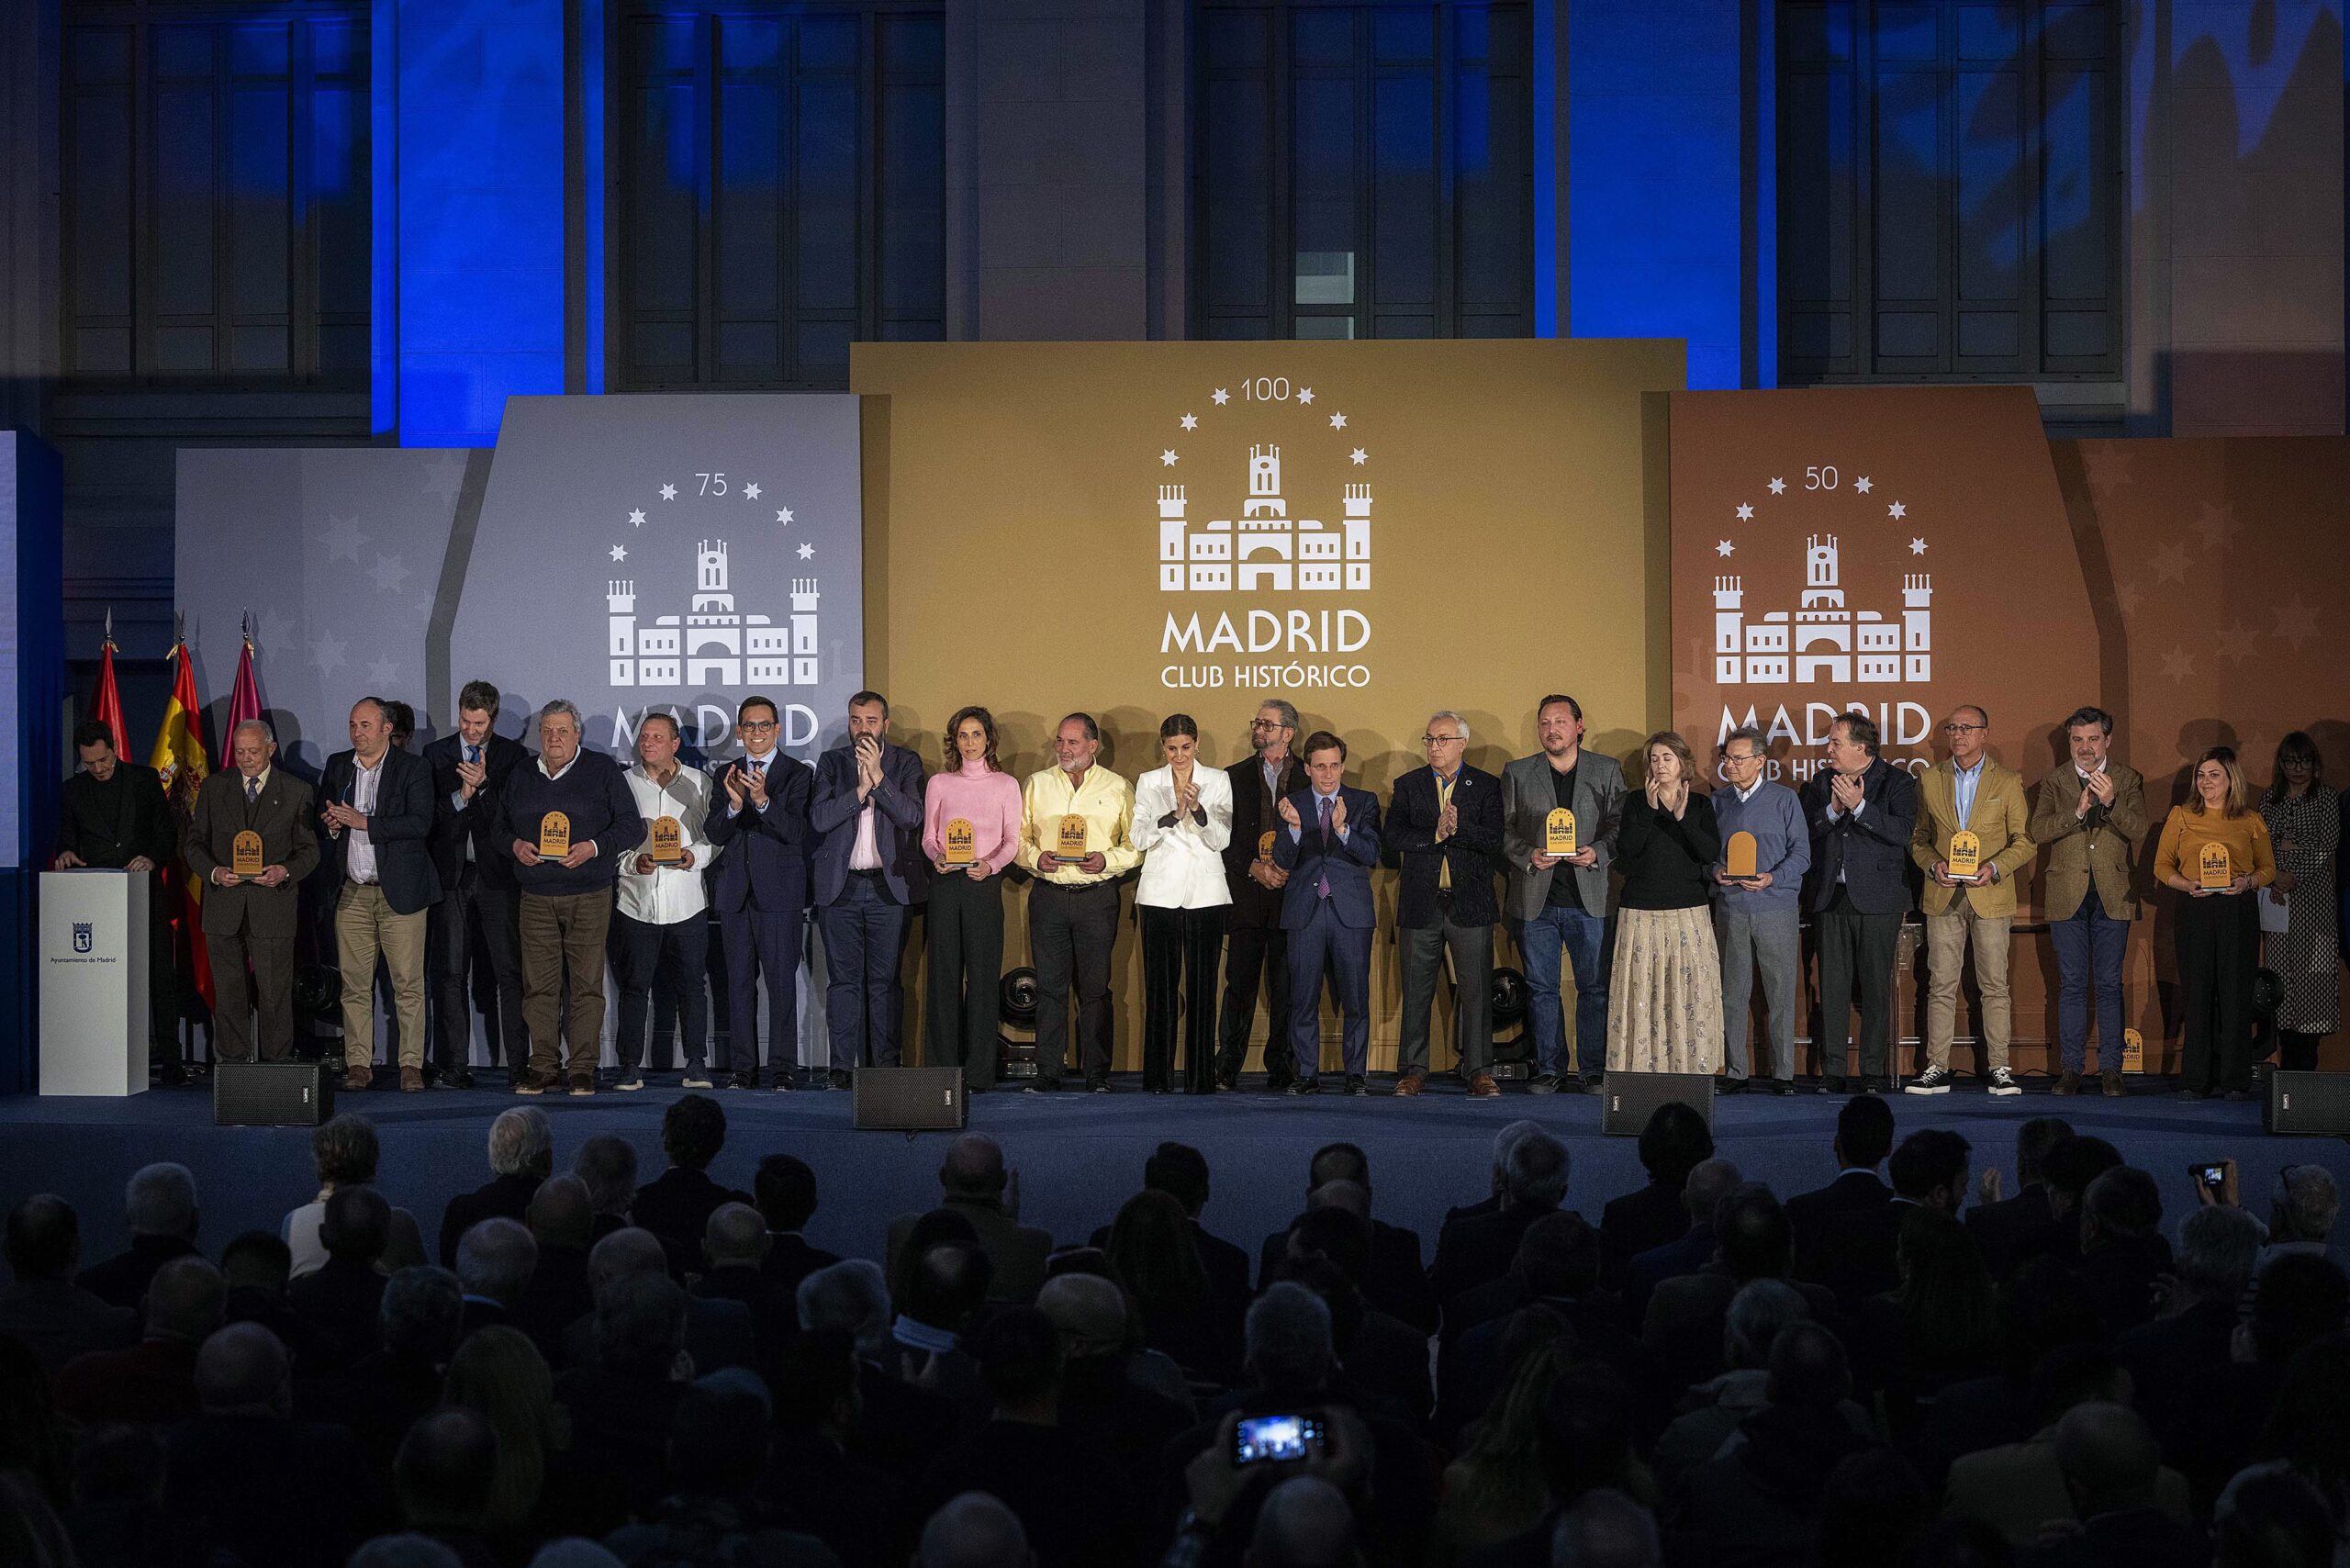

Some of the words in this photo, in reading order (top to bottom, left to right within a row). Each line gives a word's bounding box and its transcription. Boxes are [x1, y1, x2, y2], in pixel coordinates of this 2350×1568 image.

[1241, 376, 1290, 401] 100
[695, 473, 727, 496] 75
[1805, 465, 1839, 490] 50
[1160, 609, 1371, 654] MADRID
[1160, 665, 1225, 689] CLUB
[1235, 660, 1371, 688] HISTÓRICO
